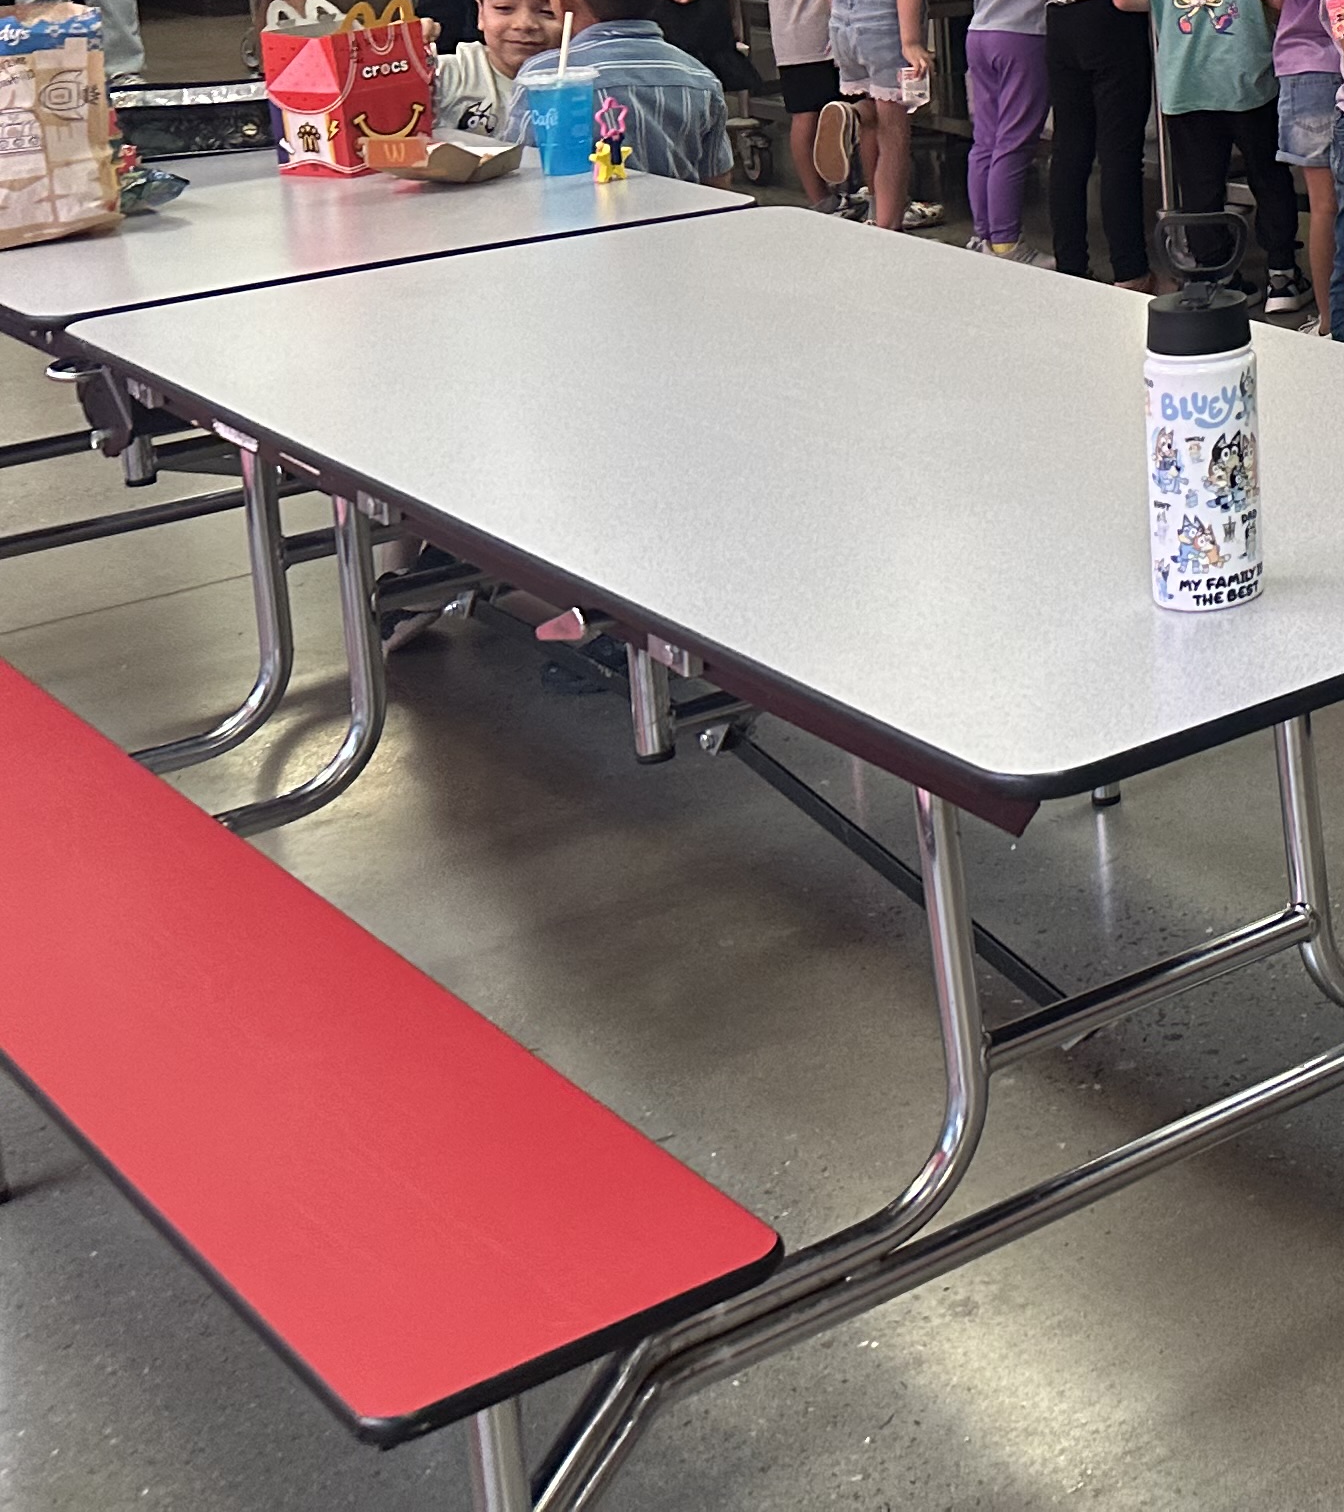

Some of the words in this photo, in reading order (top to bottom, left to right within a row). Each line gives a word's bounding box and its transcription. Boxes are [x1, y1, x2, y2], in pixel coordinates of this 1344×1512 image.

[362, 59, 409, 79] crocs
[530, 108, 559, 129] Café
[1161, 385, 1237, 429] BLUEY
[1179, 578, 1202, 591] MY
[1207, 566, 1255, 590] FAMILY
[1193, 591, 1224, 606] THE
[1227, 580, 1258, 602] BEST
